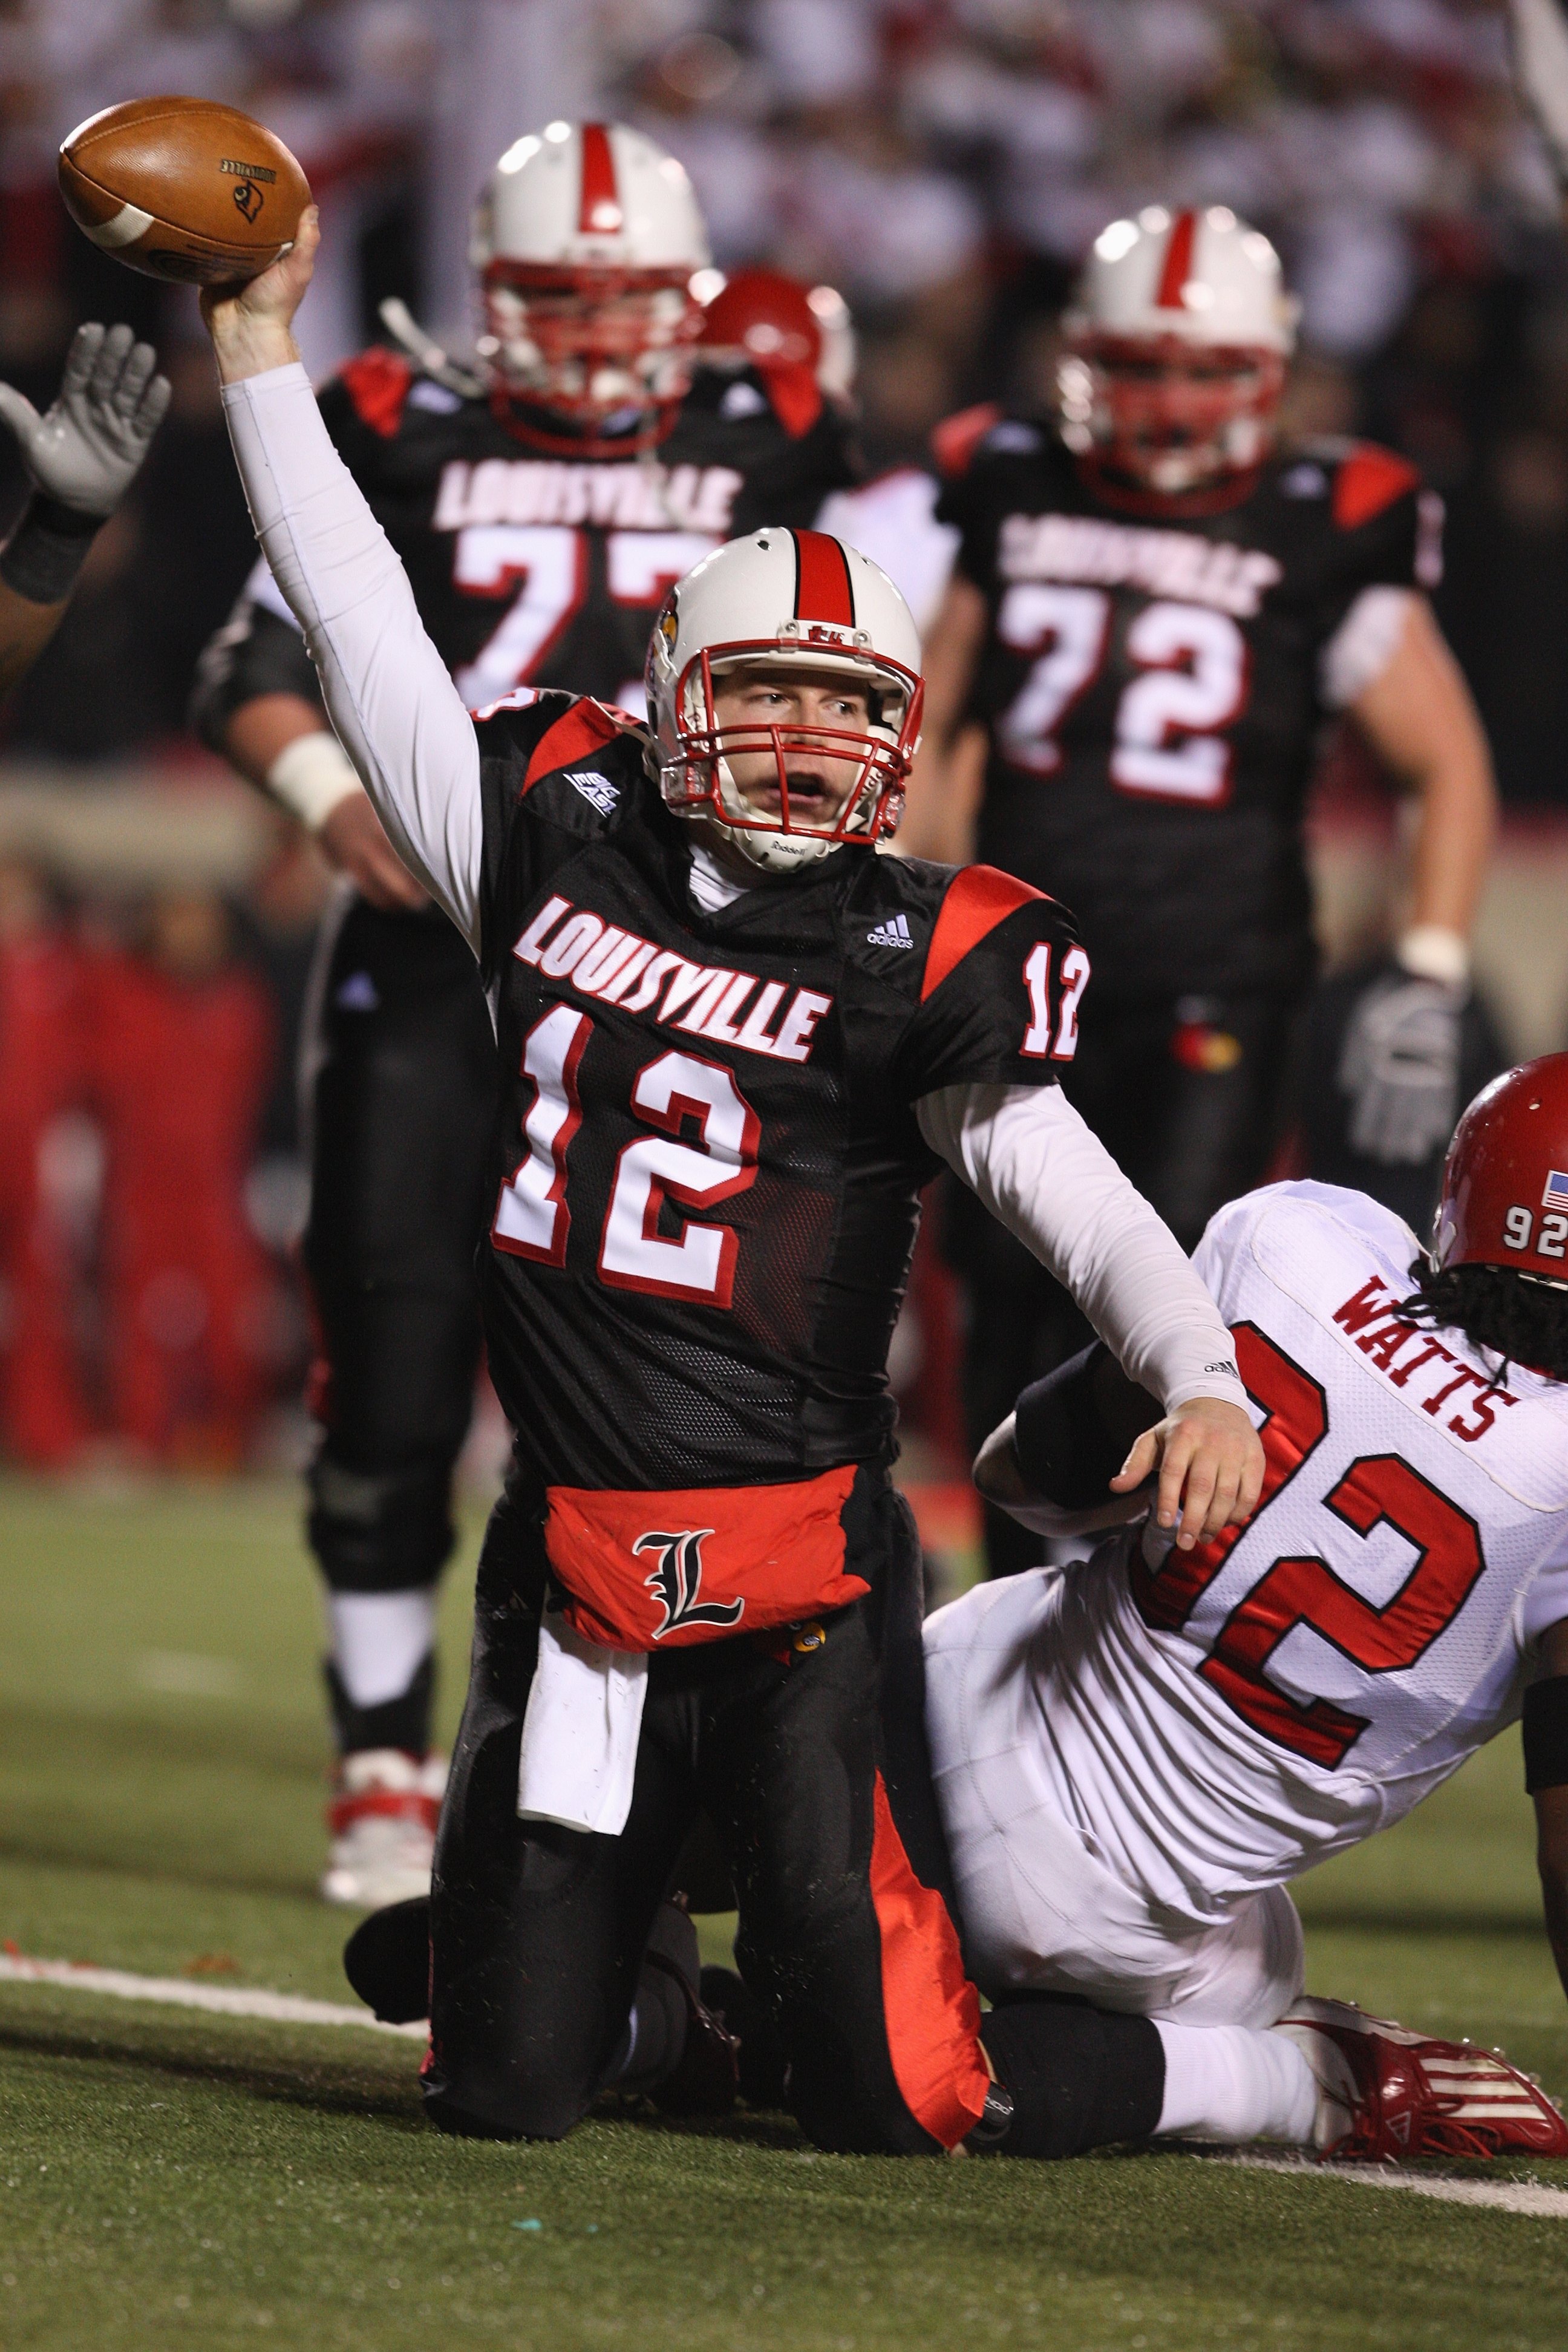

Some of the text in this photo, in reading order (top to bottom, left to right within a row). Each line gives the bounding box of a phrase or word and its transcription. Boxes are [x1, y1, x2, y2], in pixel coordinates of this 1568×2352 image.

[432, 459, 745, 534] LOUISVILLE
[997, 582, 1252, 809] 72
[512, 893, 835, 1064] LOUISVILLE
[866, 932, 914, 949] adidas
[1018, 940, 1093, 1062] 12
[489, 1001, 762, 1310] 12
[1503, 1205, 1568, 1259] 92
[1332, 1275, 1522, 1443] WATTS
[632, 1529, 745, 1641] L
